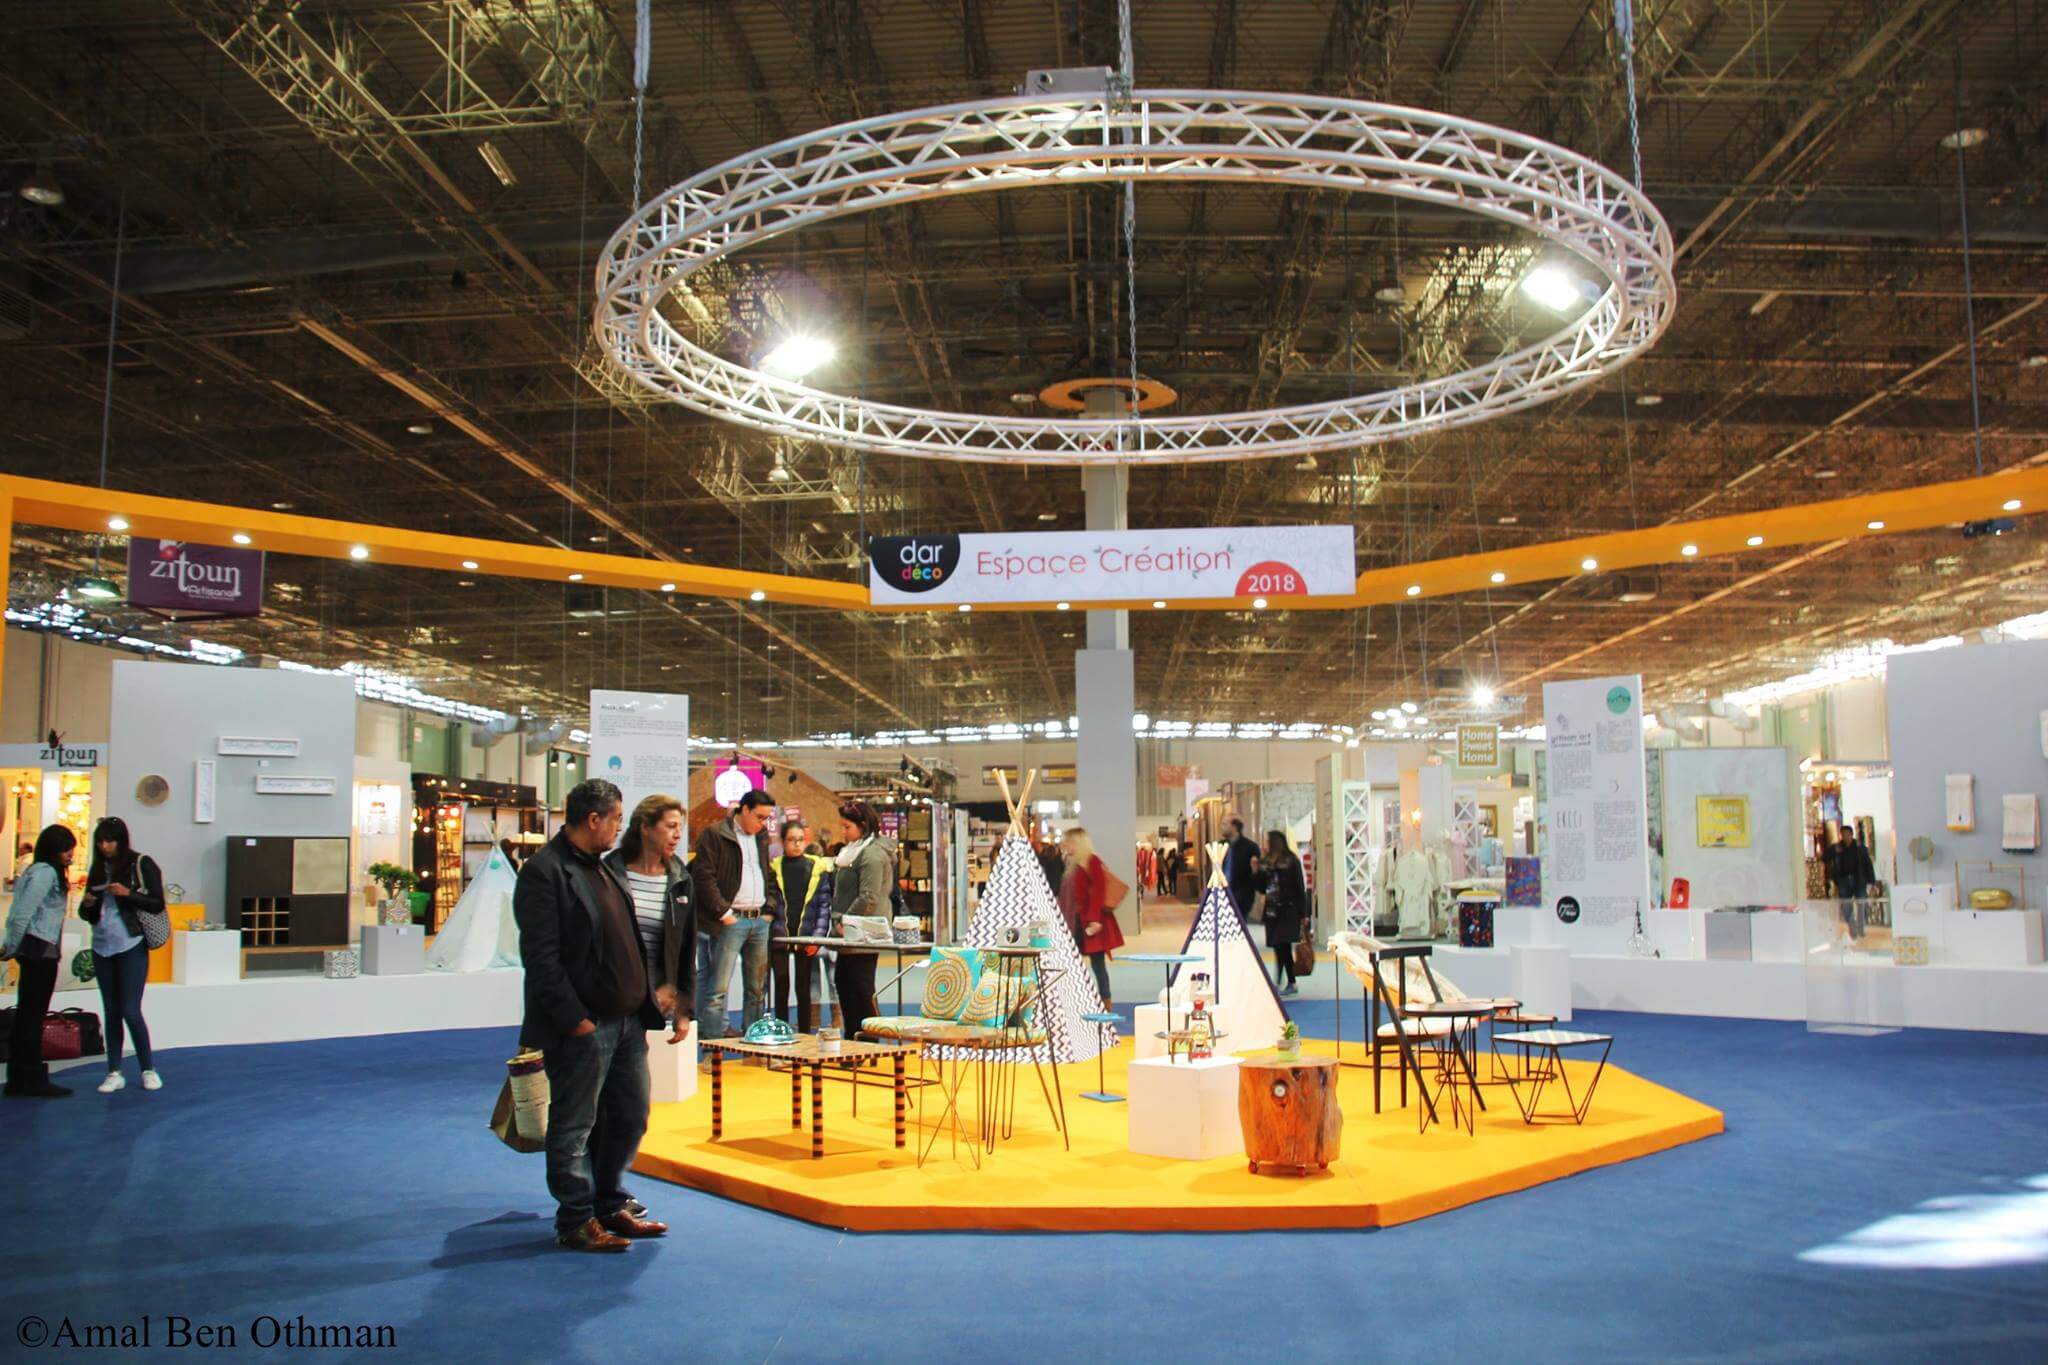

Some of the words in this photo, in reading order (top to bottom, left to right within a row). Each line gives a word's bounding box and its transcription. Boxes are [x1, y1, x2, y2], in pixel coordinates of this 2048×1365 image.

[900, 540, 943, 563] dar
[1099, 544, 1231, 574] Création
[149, 551, 241, 597] zitoun
[901, 563, 943, 580] déco
[1247, 574, 1295, 593] 2018
[1462, 729, 1494, 740] Home
[40, 744, 97, 767] zitoun
[1462, 741, 1494, 751] Sweet
[1462, 752, 1494, 762] Home
